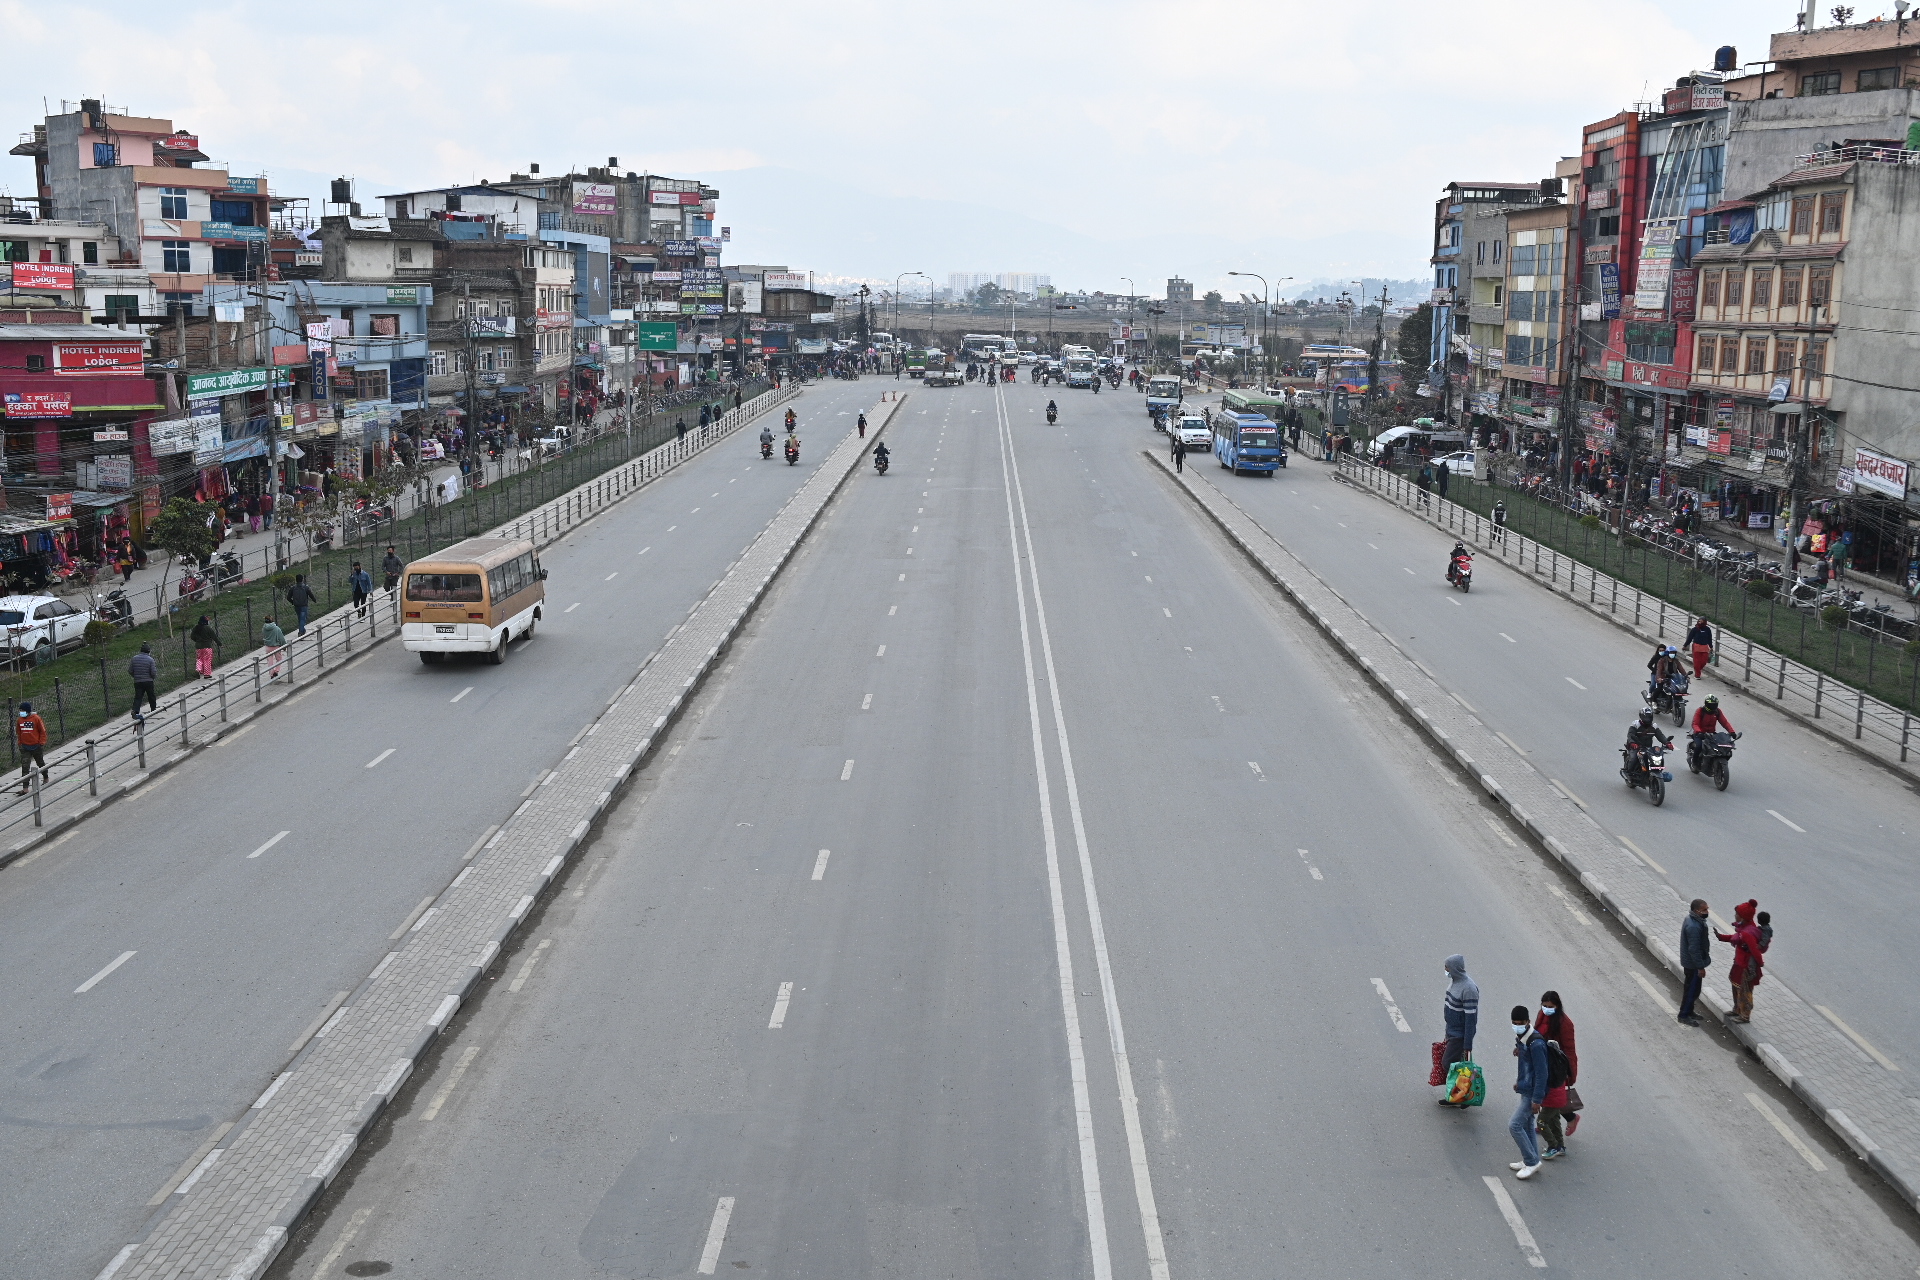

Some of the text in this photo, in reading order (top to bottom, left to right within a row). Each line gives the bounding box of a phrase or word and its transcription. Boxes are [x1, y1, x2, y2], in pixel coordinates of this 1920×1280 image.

[14, 263, 73, 274] HOTEL INDRENI
[31, 275, 57, 284] LODGE
[61, 347, 95, 355] HOTEL
[84, 358, 119, 366] LODGE
[191, 376, 217, 391] आनन्द
[250, 371, 267, 382] उपचा
[315, 356, 324, 395] SONY
[6, 402, 38, 413] हुक्का
[1767, 447, 1786, 458] TATTOO
